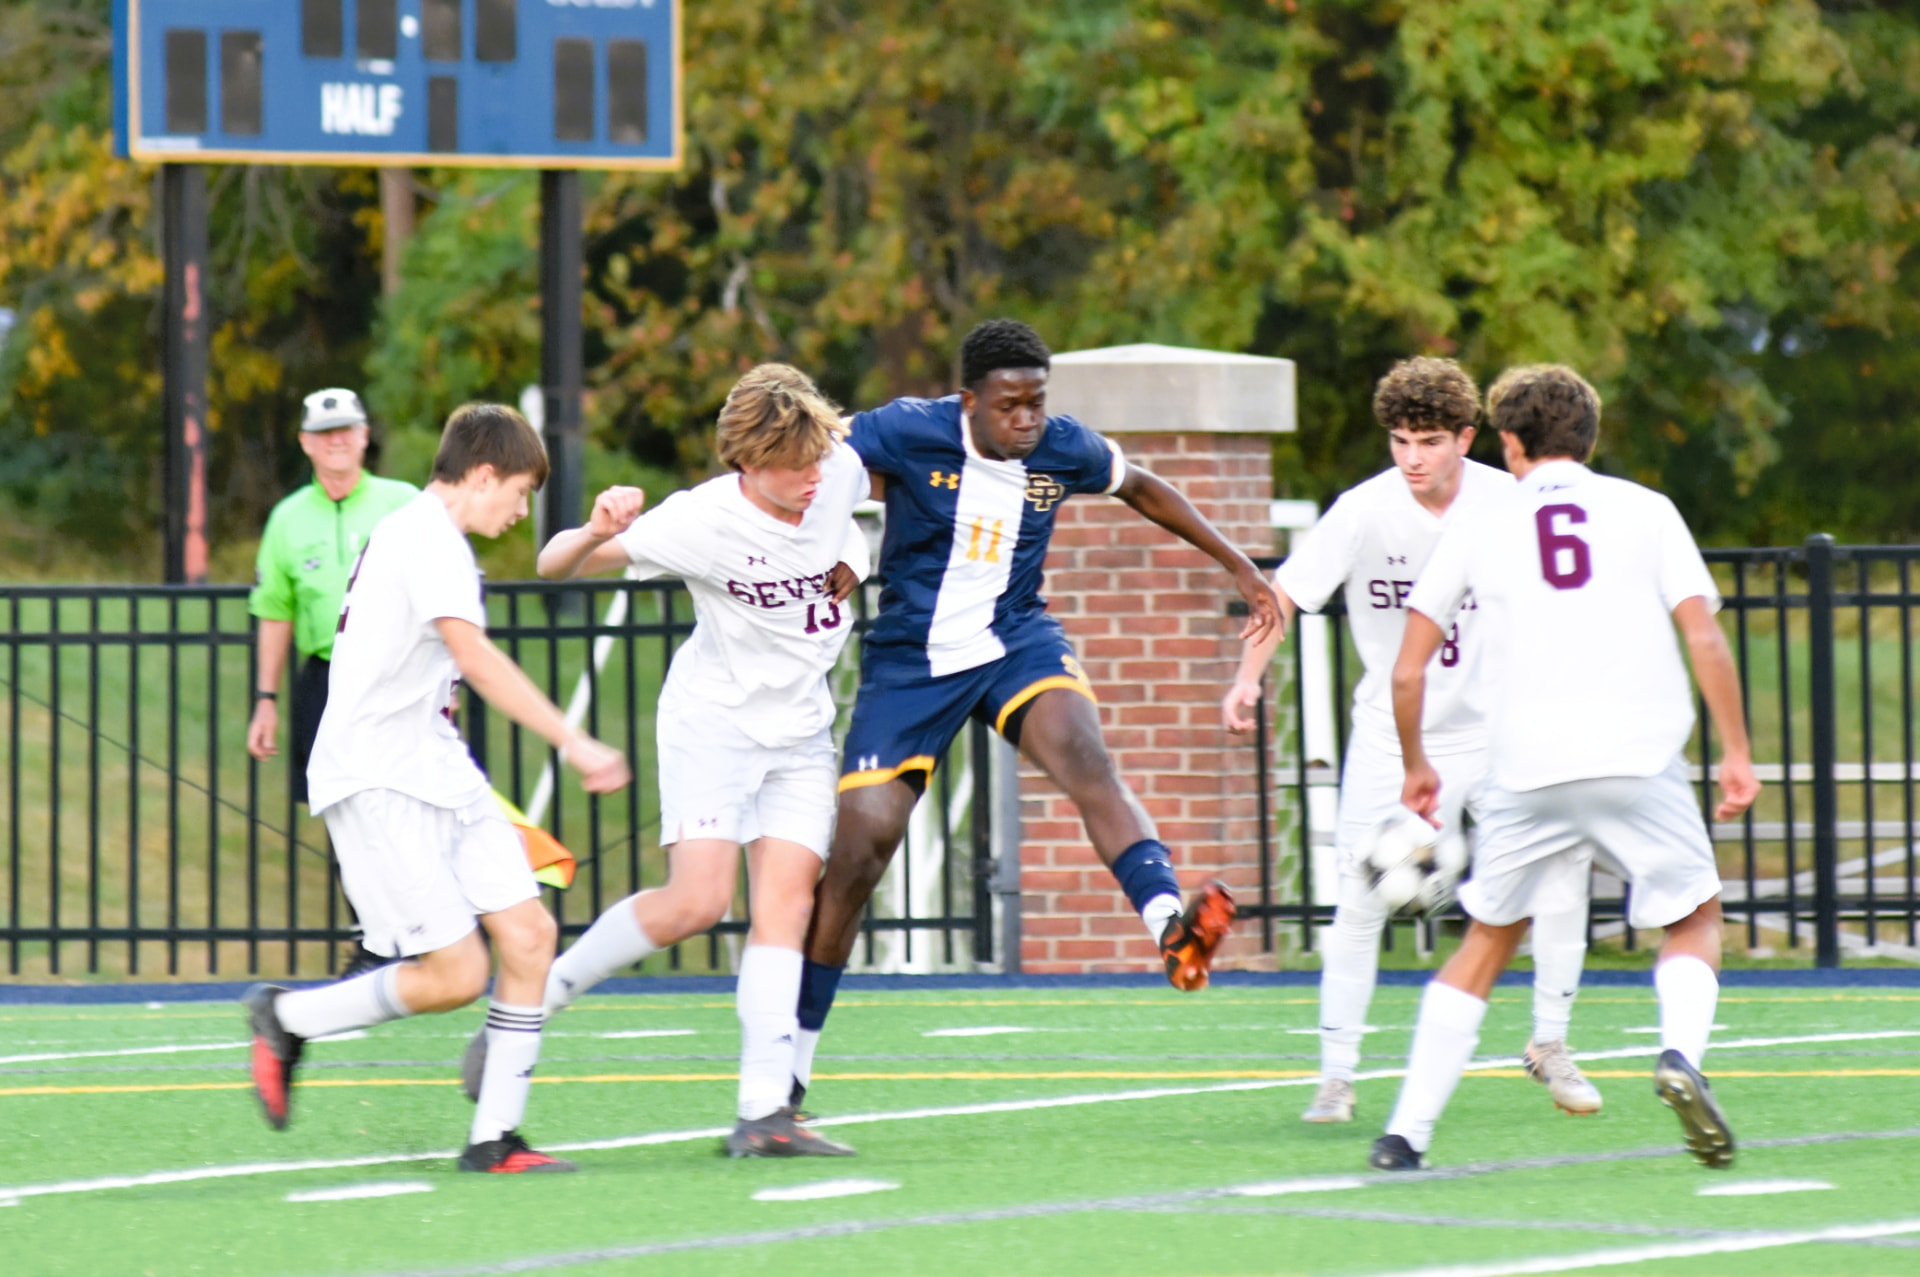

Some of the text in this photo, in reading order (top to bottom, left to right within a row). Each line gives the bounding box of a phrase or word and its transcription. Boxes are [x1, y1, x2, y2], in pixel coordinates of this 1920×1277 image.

[321, 82, 403, 135] HALF
[966, 516, 1003, 563] 11
[1535, 503, 1592, 590] 6
